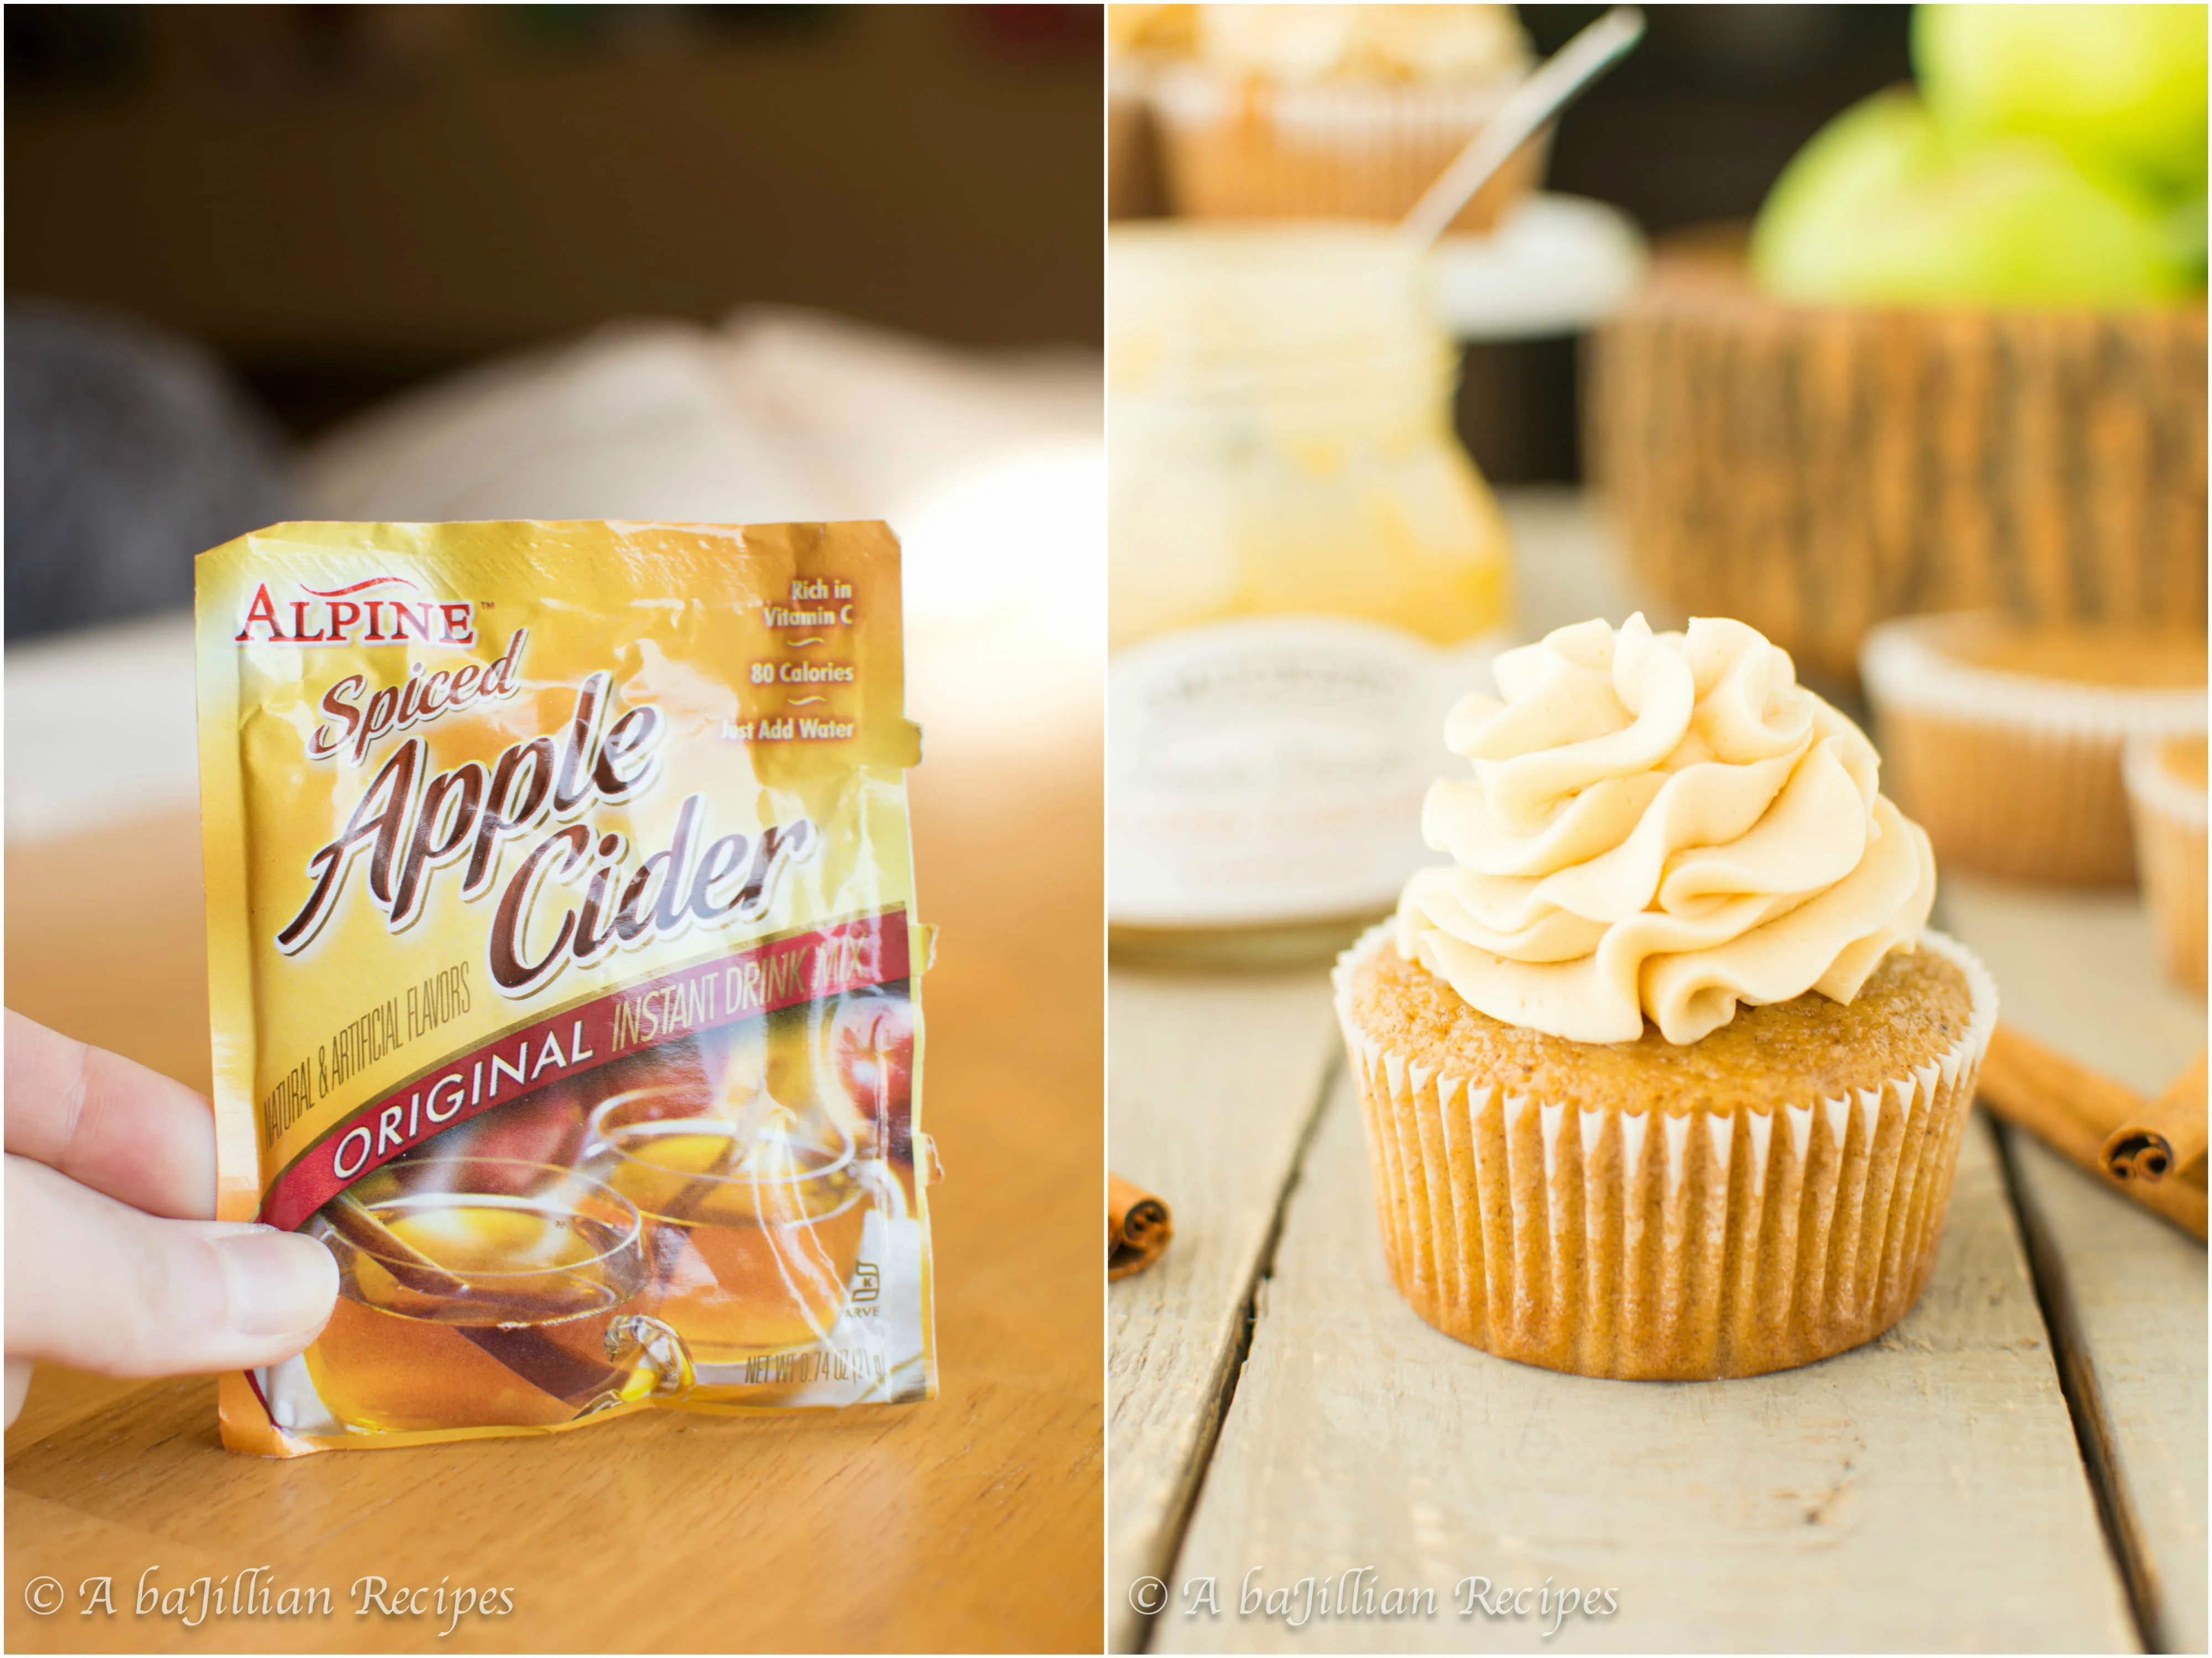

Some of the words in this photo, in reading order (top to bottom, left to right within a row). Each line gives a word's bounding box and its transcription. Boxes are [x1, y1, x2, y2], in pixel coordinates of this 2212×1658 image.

[234, 582, 474, 644] ALPINE
[791, 578, 829, 601] Rich
[834, 580, 852, 599] in
[763, 606, 836, 628] Vitamin
[840, 604, 853, 625] C
[306, 627, 530, 766] Spiced
[750, 663, 775, 685] 80
[779, 660, 854, 684] Calories
[720, 719, 754, 741] Just
[758, 718, 794, 740] Add
[799, 717, 854, 739] Water
[275, 670, 660, 953] Apple
[488, 792, 816, 994] Cider
[263, 1056, 315, 1154] NATURAL
[318, 1045, 330, 1099] &
[331, 996, 404, 1091] ARTIFICIAL
[406, 961, 471, 1042] FLAVORS
[333, 1020, 595, 1181] ORIGINAL
[611, 971, 720, 1053] INSTANT
[725, 946, 808, 1015] DRINK
[812, 931, 867, 990] MIX
[844, 1306, 880, 1318] ARVE
[744, 1354, 773, 1384] NET
[775, 1352, 797, 1384] WT
[800, 1350, 831, 1383] 0.74
